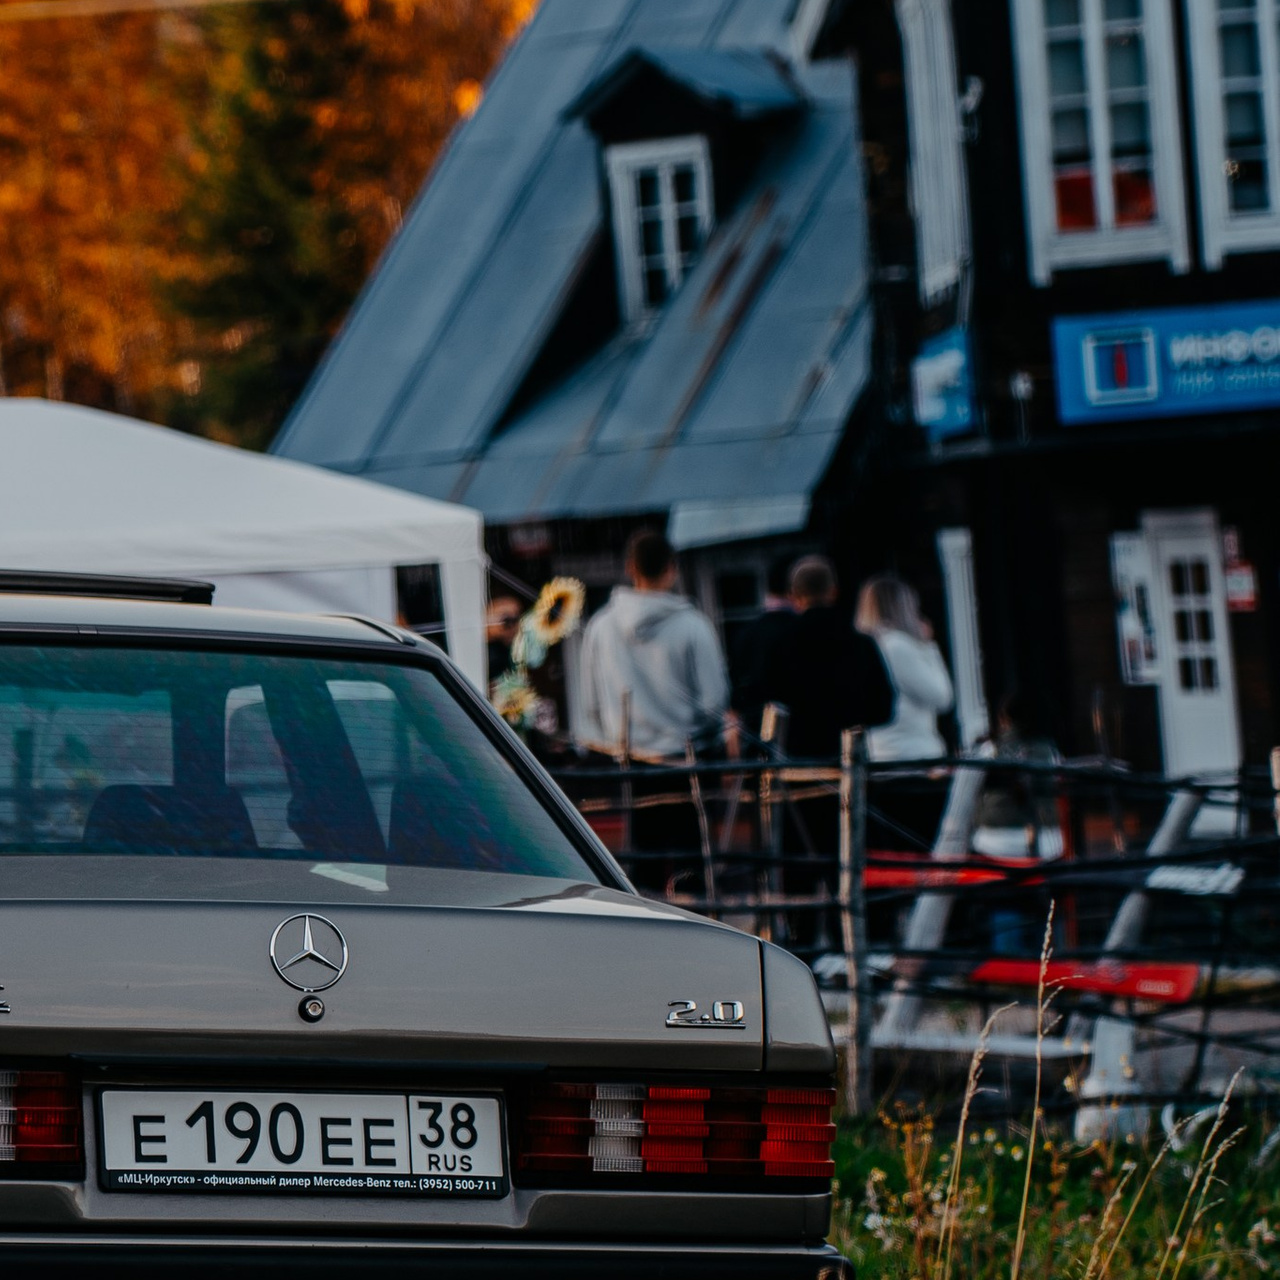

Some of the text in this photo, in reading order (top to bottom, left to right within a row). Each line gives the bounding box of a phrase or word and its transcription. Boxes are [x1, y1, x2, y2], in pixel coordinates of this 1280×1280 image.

[667, 1000, 745, 1021] 2.0
[417, 1100, 478, 1150] 38
[428, 1153, 473, 1173] RUS
[117, 1173, 195, 1186] «МЦ-Иркутск»
[203, 1175, 276, 1187] официальный
[279, 1177, 311, 1188] дилер
[313, 1176, 391, 1188] Mercedes-Benz
[393, 1179, 417, 1189] тел.:
[419, 1178, 453, 1191] (3952)
[455, 1179, 496, 1191] 500-711
